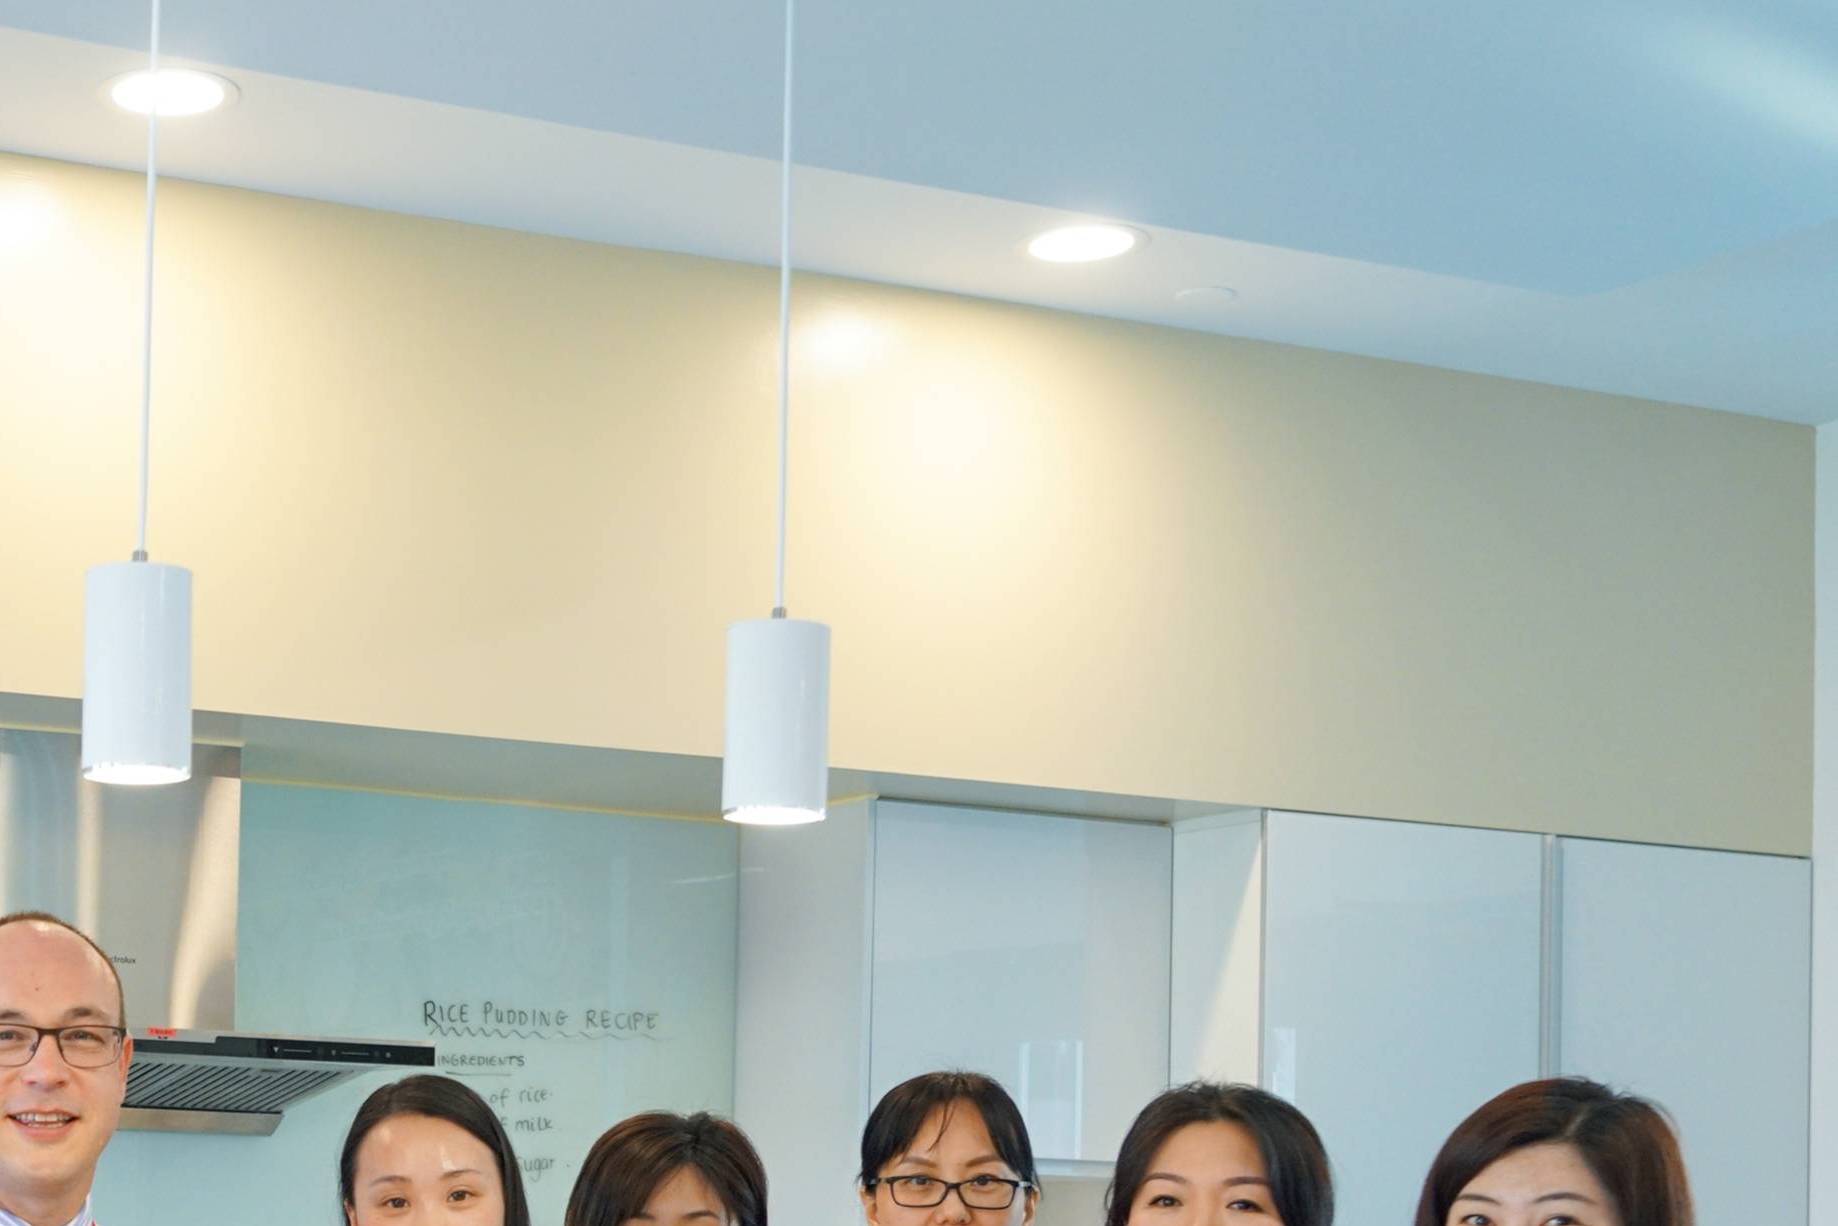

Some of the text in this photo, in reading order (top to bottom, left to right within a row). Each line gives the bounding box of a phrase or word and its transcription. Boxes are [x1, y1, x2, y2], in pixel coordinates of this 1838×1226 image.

[423, 1000, 659, 1031] RICE PUDDING RECIPE
[437, 1054, 526, 1067] INGREDIENTS
[489, 1088, 510, 1108] of
[515, 1117, 554, 1132] milk
